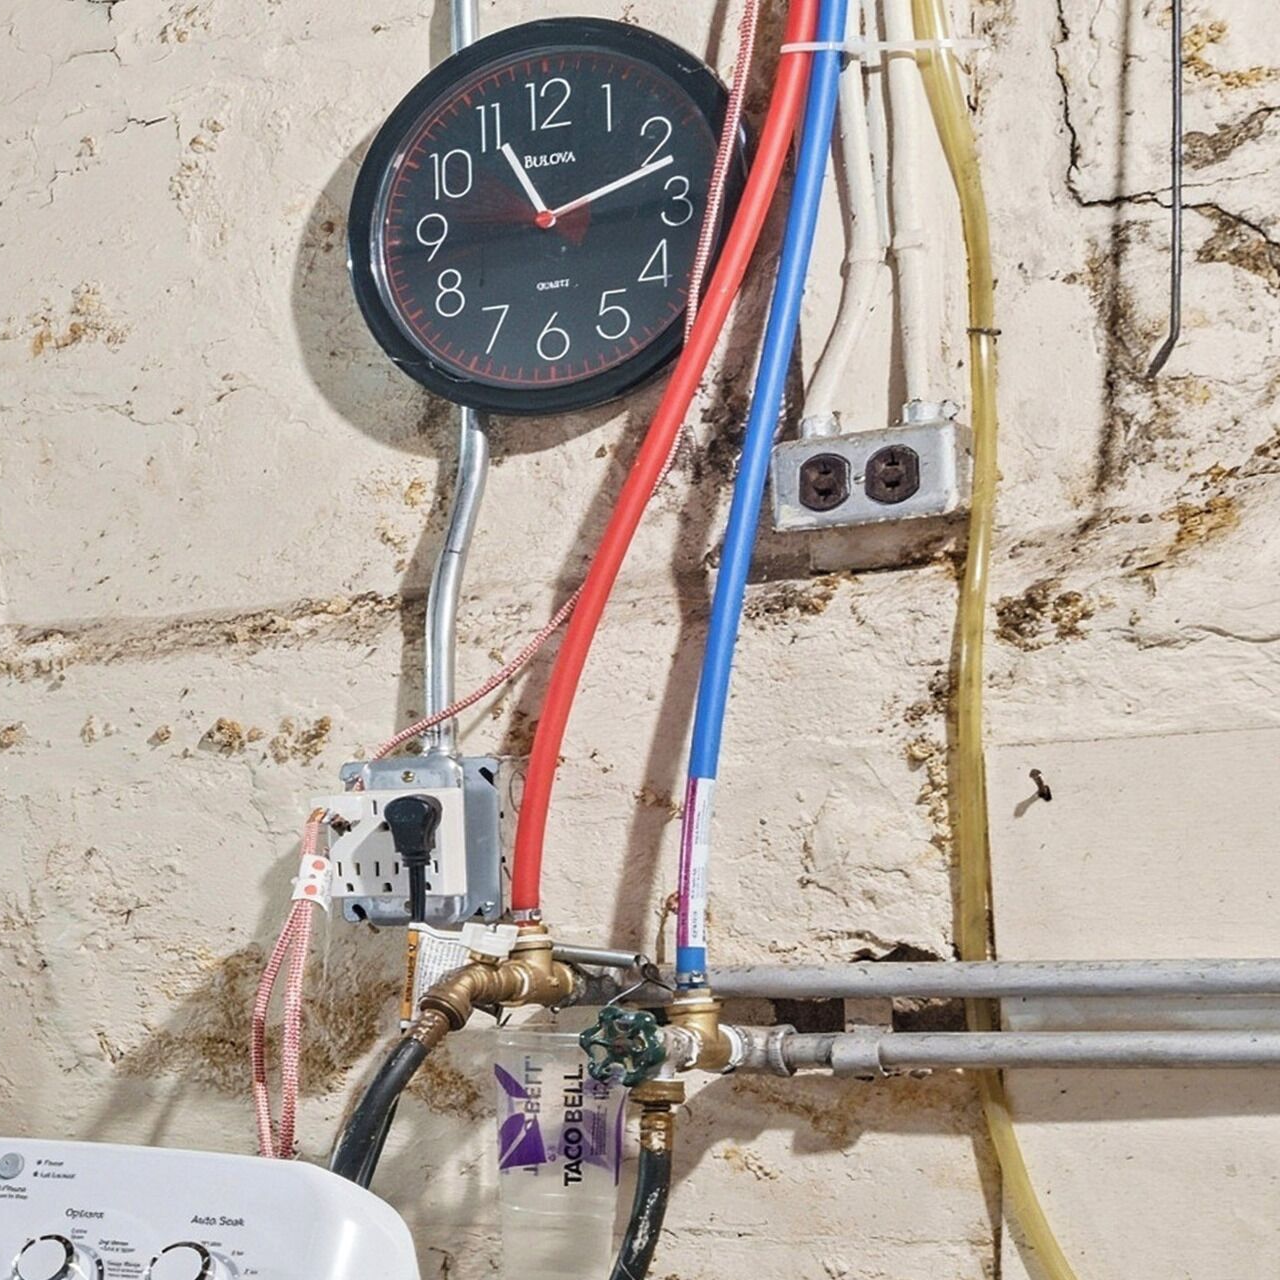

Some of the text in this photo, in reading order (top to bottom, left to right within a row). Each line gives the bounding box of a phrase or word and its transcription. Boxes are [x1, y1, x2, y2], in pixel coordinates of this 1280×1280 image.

[476, 102, 501, 153] 11
[525, 77, 572, 131] 12
[601, 83, 612, 132] 1
[524, 151, 576, 169] BULOVA
[640, 116, 672, 168] 2
[429, 149, 472, 200] 10
[660, 175, 693, 226] 3
[416, 212, 448, 262] 9
[637, 238, 672, 287] 4
[435, 268, 465, 317] 8
[595, 288, 630, 340] 5
[481, 304, 509, 354] 7
[536, 311, 570, 361] 6
[564, 1127, 583, 1186] TACO
[191, 1215, 245, 1227] Auto Soak
